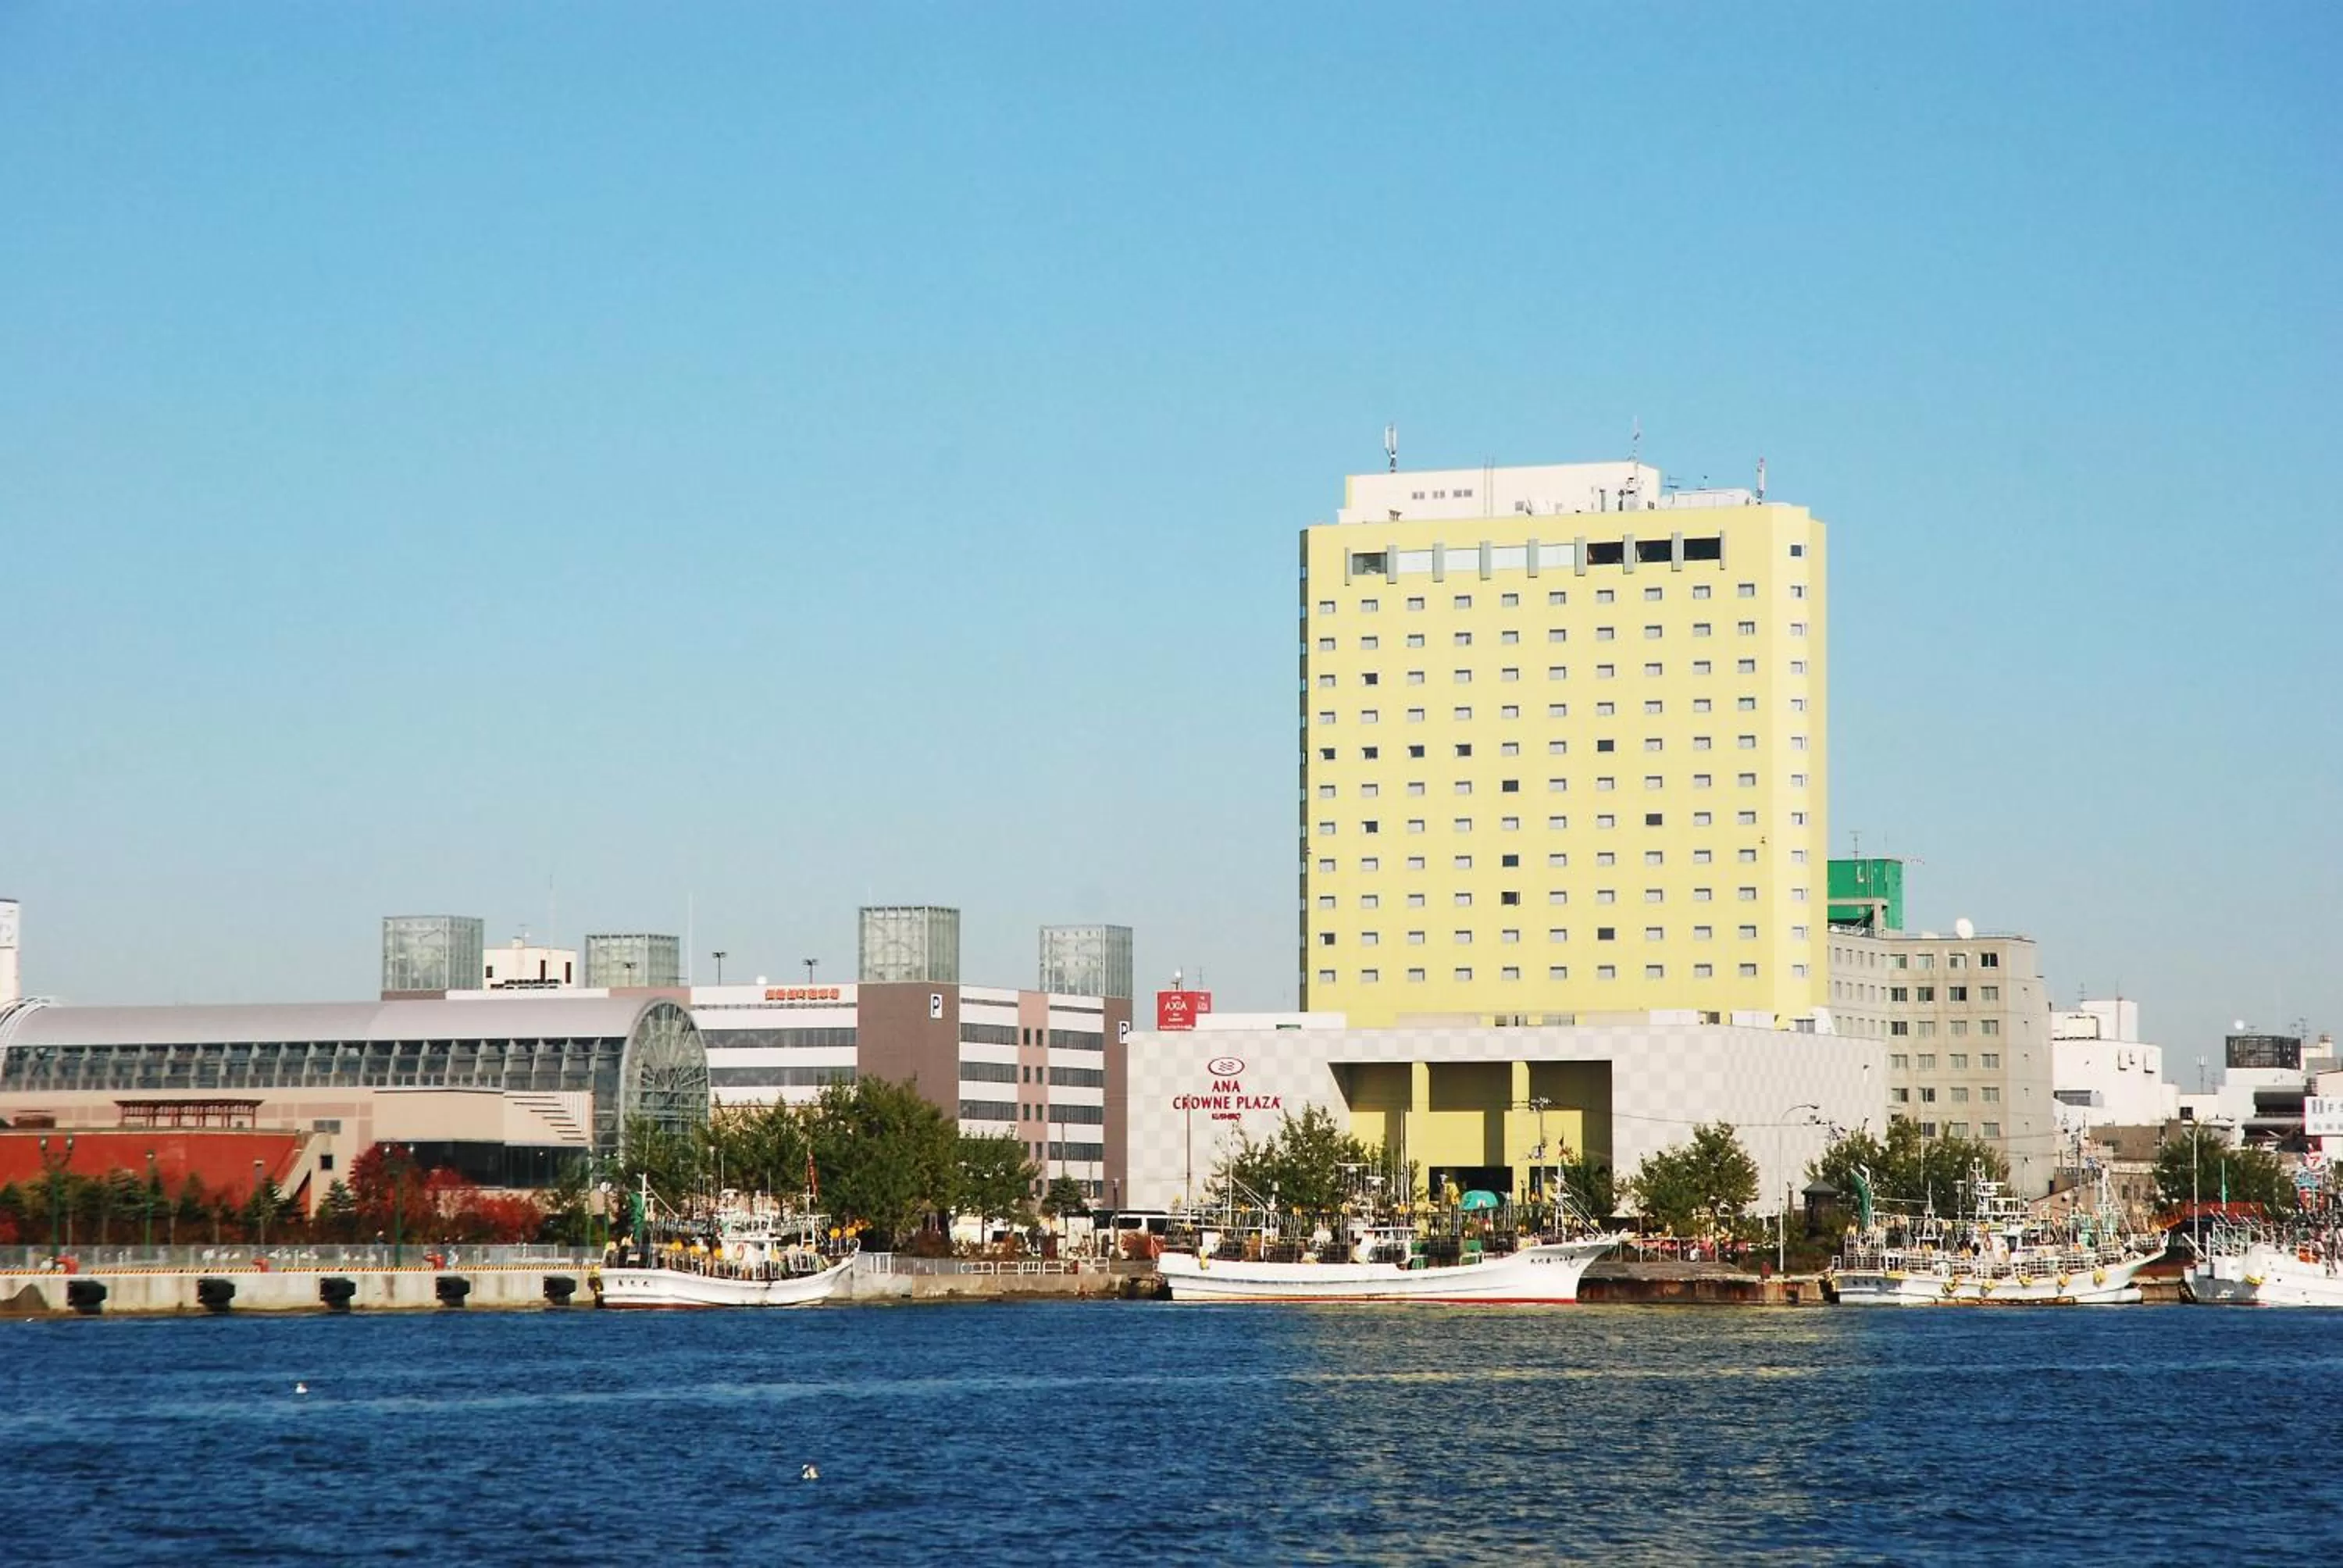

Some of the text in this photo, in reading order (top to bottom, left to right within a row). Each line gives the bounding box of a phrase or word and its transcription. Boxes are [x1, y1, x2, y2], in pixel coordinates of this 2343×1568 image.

[932, 996, 940, 1016] P
[1121, 1022, 1129, 1041] P
[1211, 1080, 1241, 1092] ANA
[1172, 1096, 1281, 1110] CROWNE PLAZA
